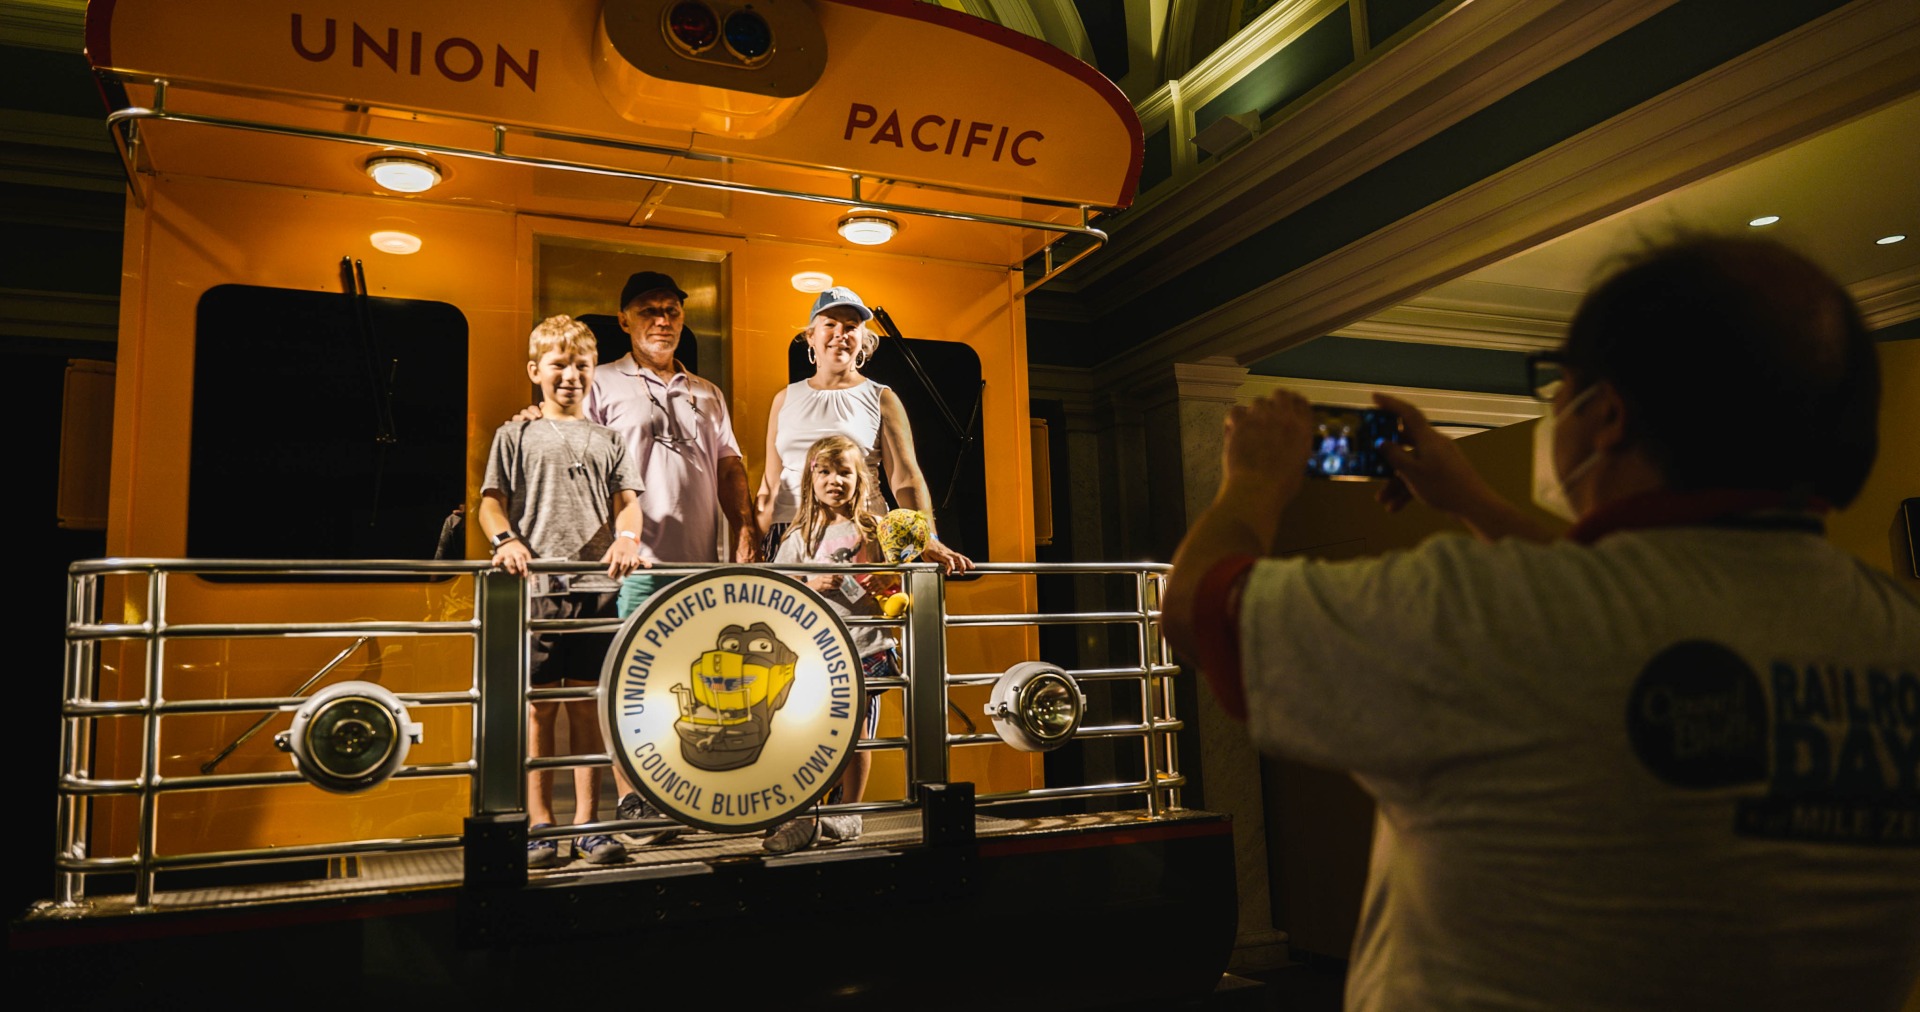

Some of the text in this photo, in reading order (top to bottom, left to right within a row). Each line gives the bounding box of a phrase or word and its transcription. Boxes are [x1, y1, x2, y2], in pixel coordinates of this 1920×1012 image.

[291, 13, 1044, 166] UNION PACIFIC
[624, 582, 851, 720] UNION PACIFIC RAILROAD MUSEUM
[633, 742, 838, 817] COUNCIL BLUFFS, IOWA
